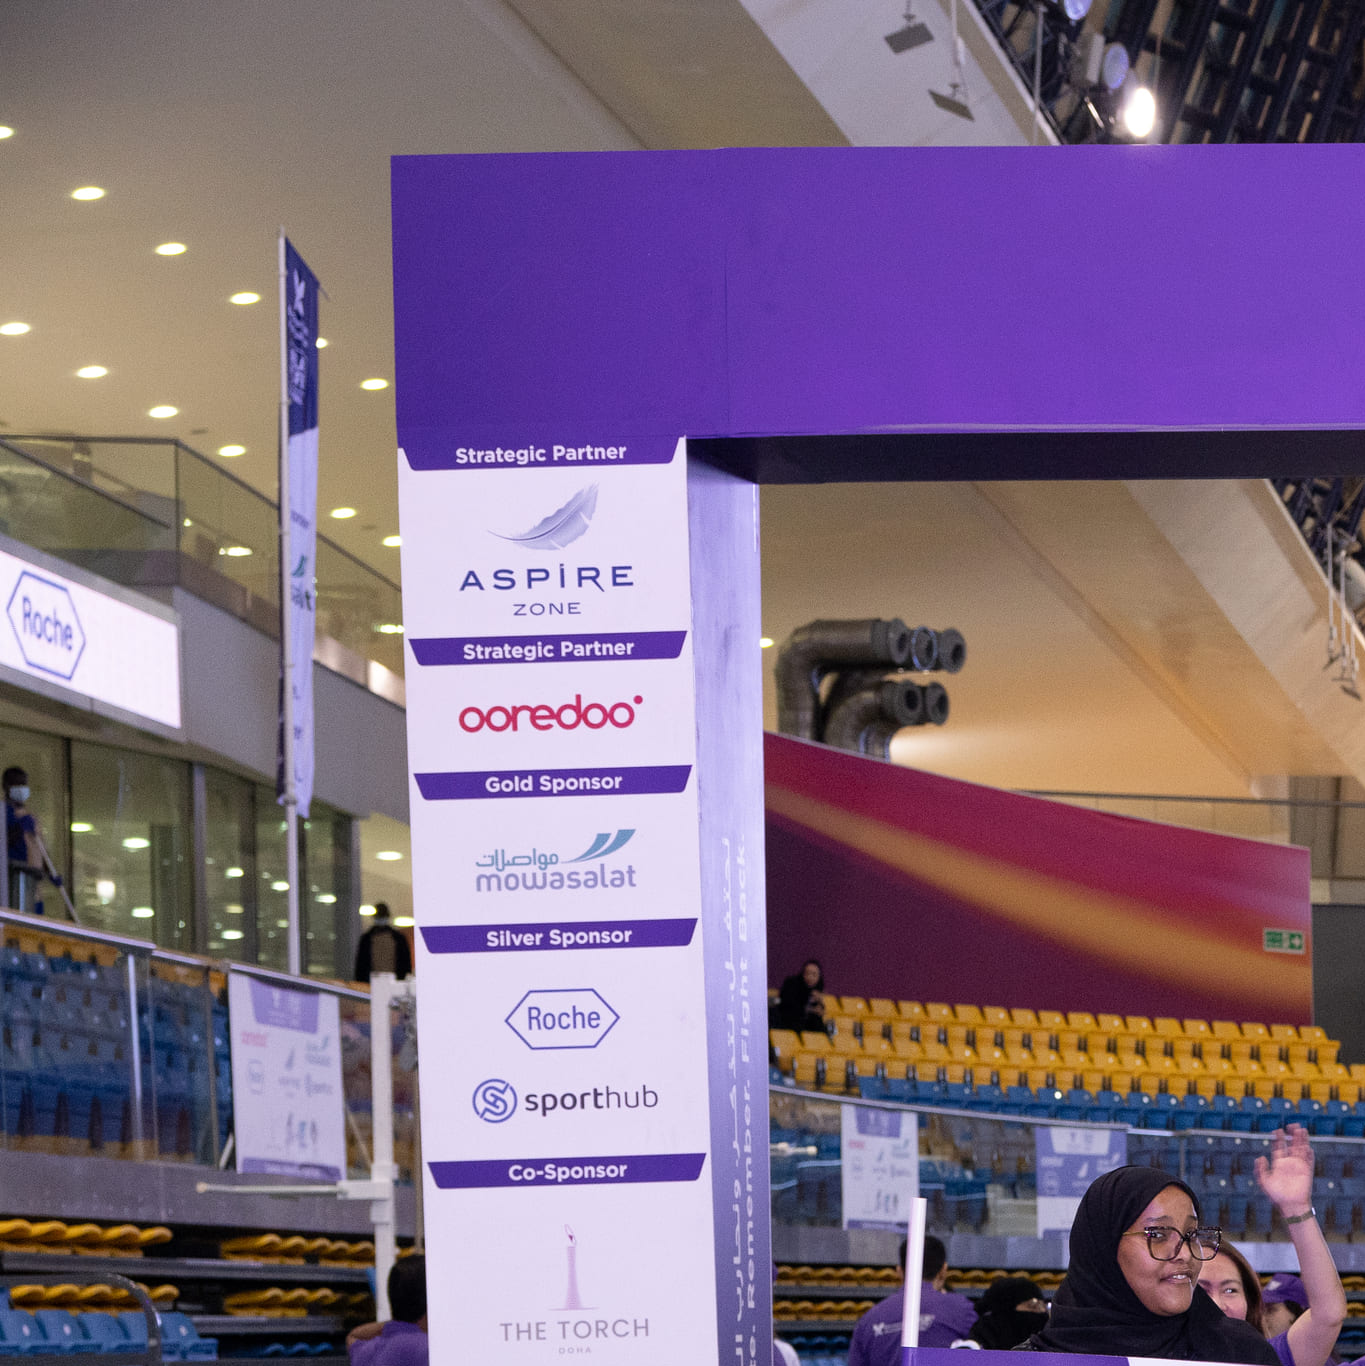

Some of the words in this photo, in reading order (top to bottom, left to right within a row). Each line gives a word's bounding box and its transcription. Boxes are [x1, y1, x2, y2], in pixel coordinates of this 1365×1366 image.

[456, 446, 546, 464] Strategic
[553, 445, 626, 460] Partner
[513, 602, 581, 616] ZONE
[21, 594, 73, 652] Roche
[464, 642, 554, 661] Strategic
[561, 641, 634, 656] Partner
[459, 694, 635, 733] ooredoo
[486, 776, 533, 792] Gold
[540, 776, 622, 793] Sponsor
[476, 848, 558, 871] مواصلات
[476, 864, 637, 893] mowasalat
[737, 834, 747, 942] Back.
[487, 930, 543, 946] Silver
[550, 929, 632, 947] Sponsor
[528, 1005, 600, 1030] Roche
[740, 956, 751, 1063] Fight
[525, 1085, 658, 1117] sporthub
[509, 1161, 627, 1182] Co-Sponsor
[743, 1080, 756, 1308] Remember.
[500, 1322, 546, 1341] THE
[558, 1319, 648, 1339] TORCH
